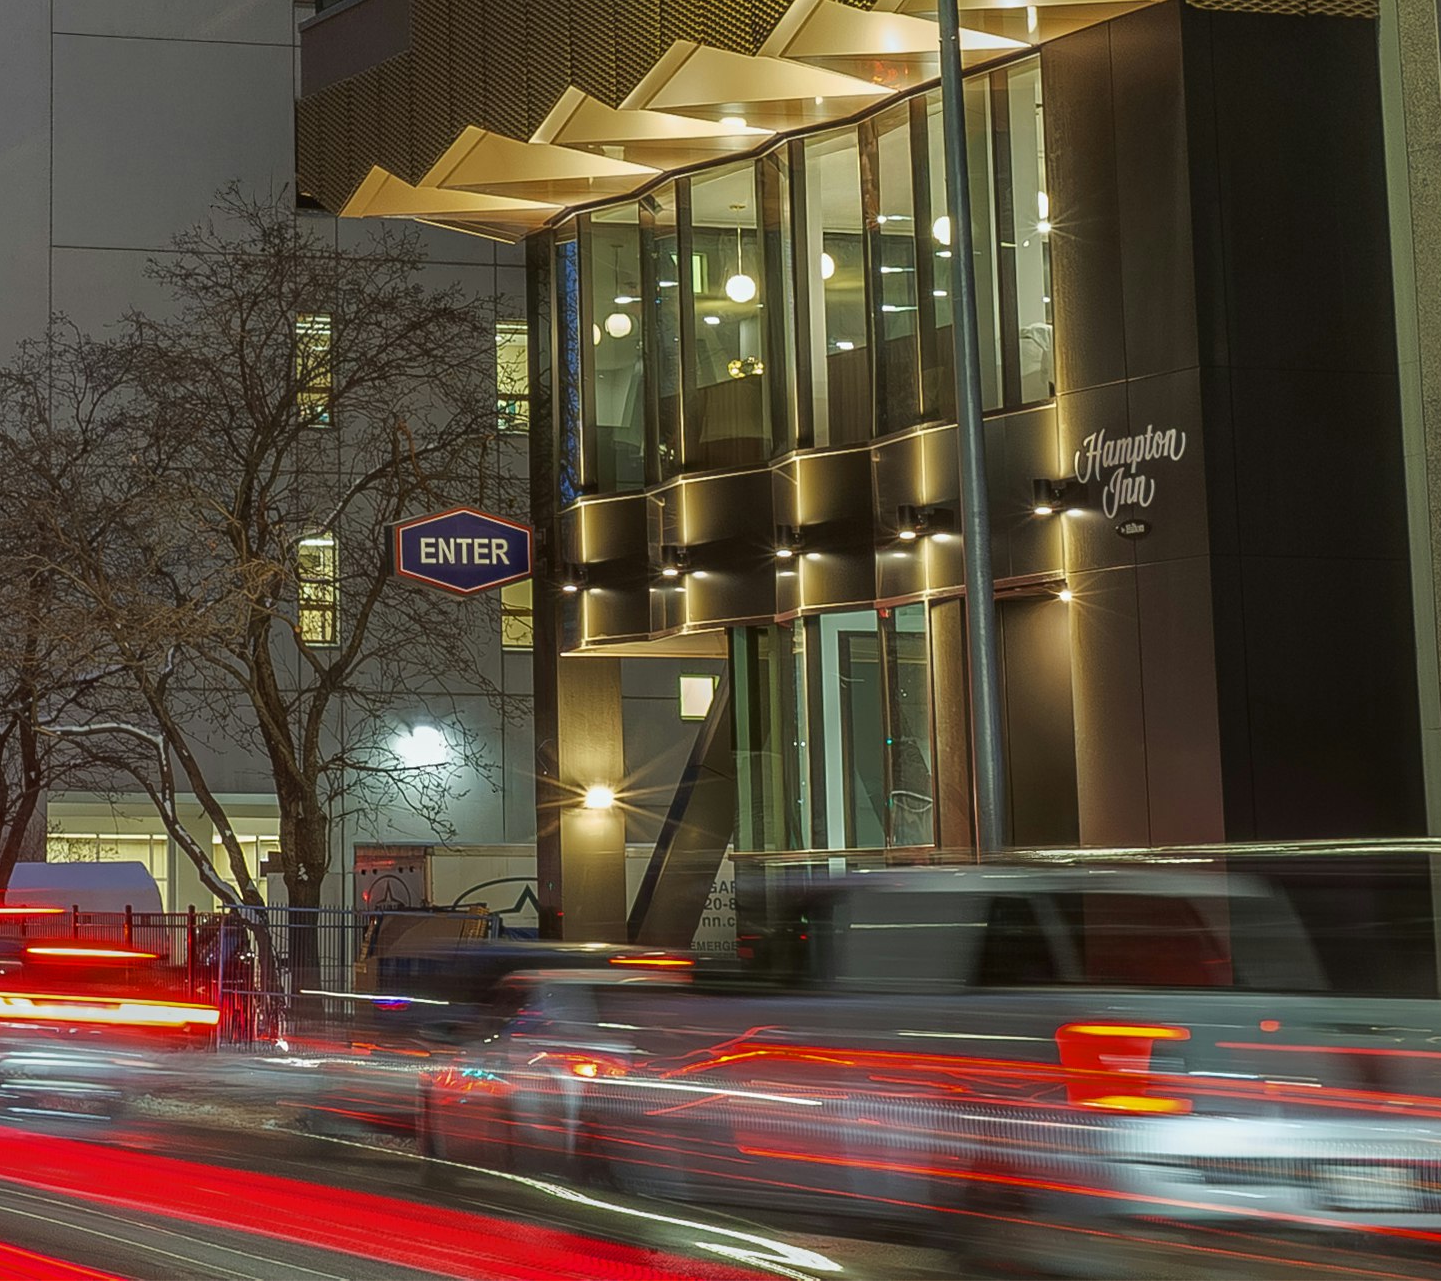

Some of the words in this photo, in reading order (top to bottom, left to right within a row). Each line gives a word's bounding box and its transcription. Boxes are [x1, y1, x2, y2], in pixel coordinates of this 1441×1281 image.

[1074, 424, 1186, 484] Hampton
[1102, 467, 1155, 519] Inn
[420, 537, 511, 565] ENTER
